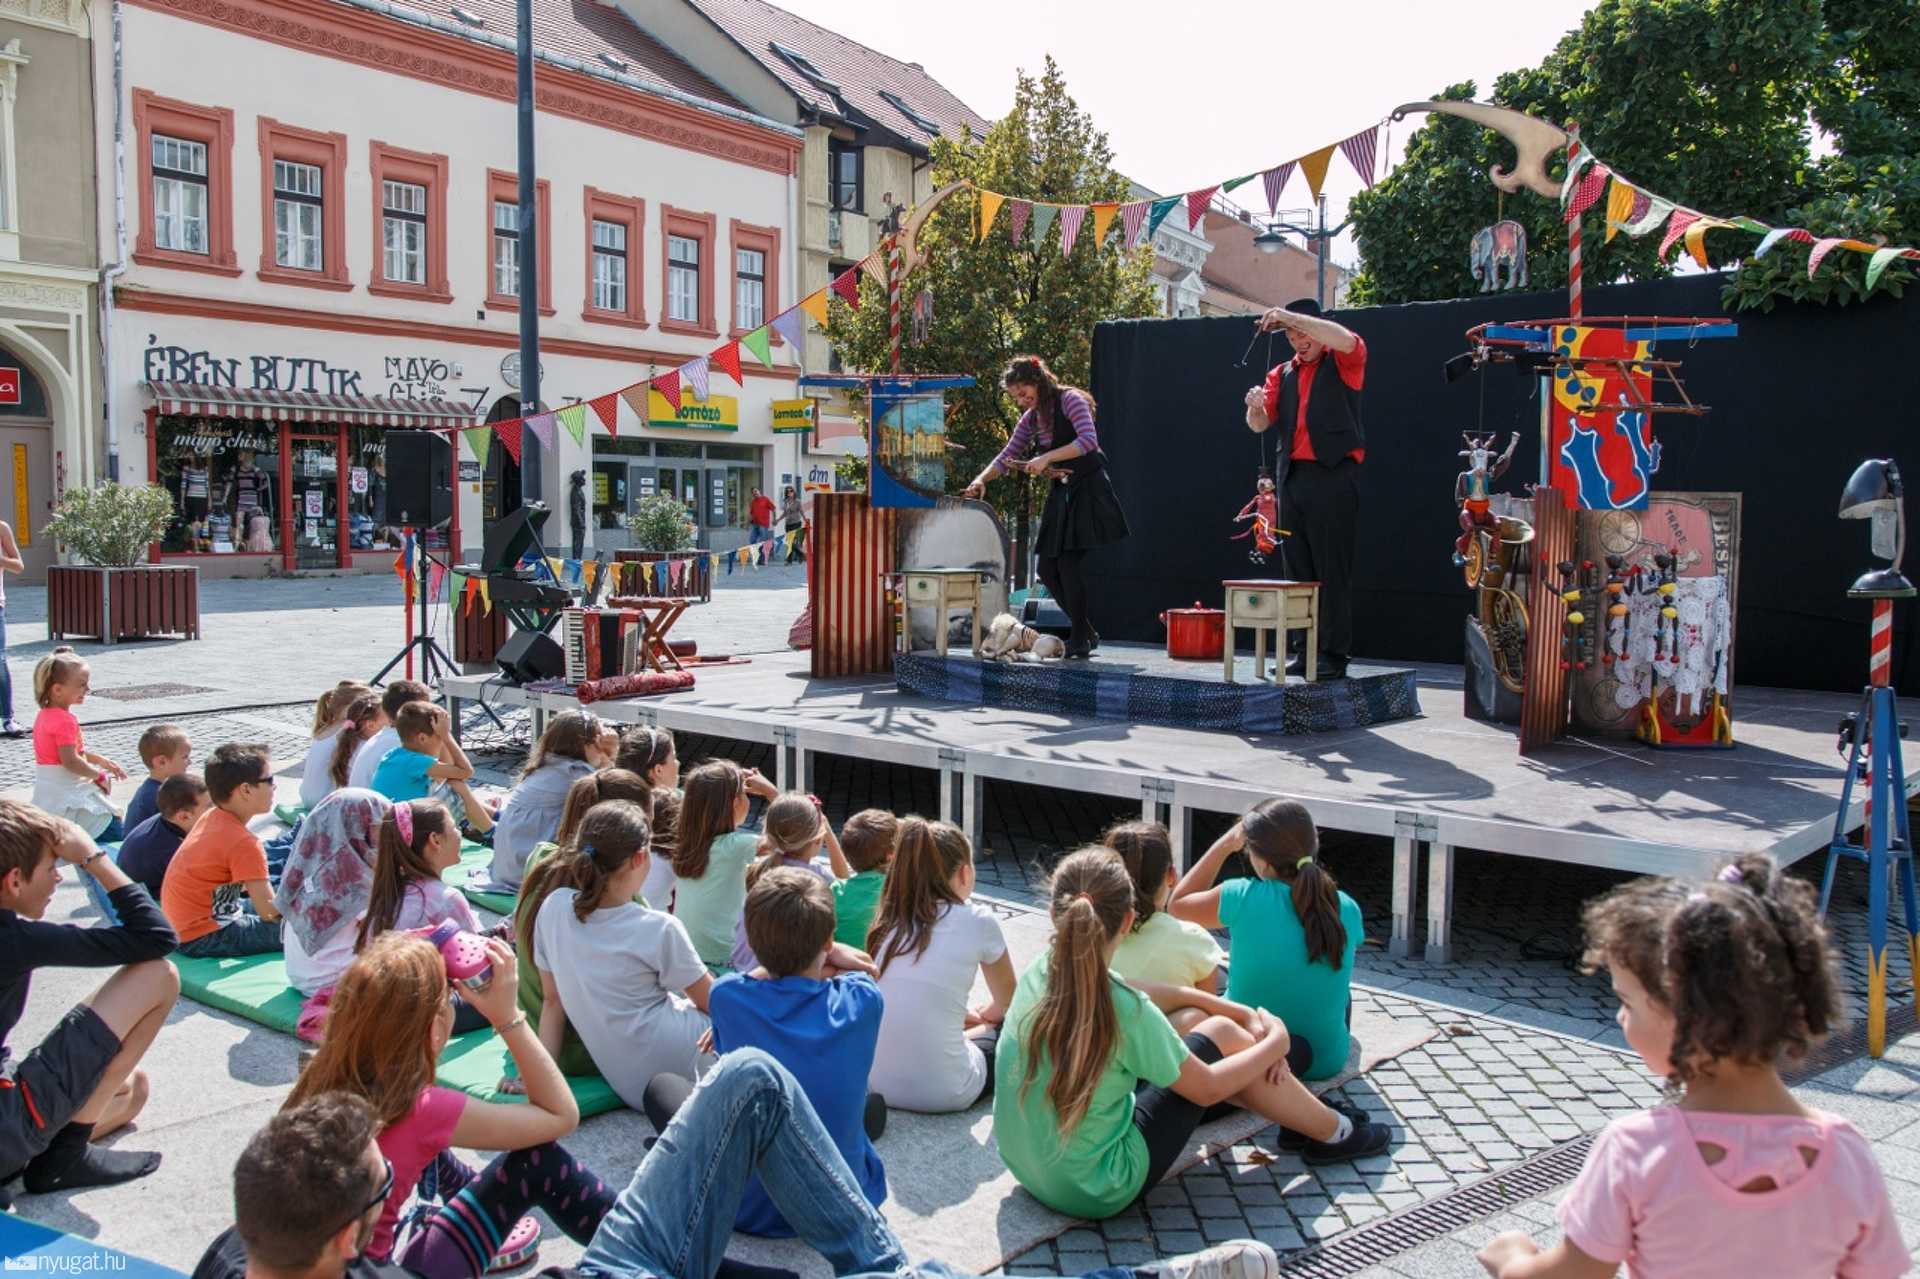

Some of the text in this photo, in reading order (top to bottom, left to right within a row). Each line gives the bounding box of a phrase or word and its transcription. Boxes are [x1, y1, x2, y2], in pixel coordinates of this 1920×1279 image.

[144, 333, 364, 397] ÉBEN BUTIK
[384, 356, 448, 387] MAYO
[173, 434, 226, 456] mayo
[809, 464, 829, 483] dm
